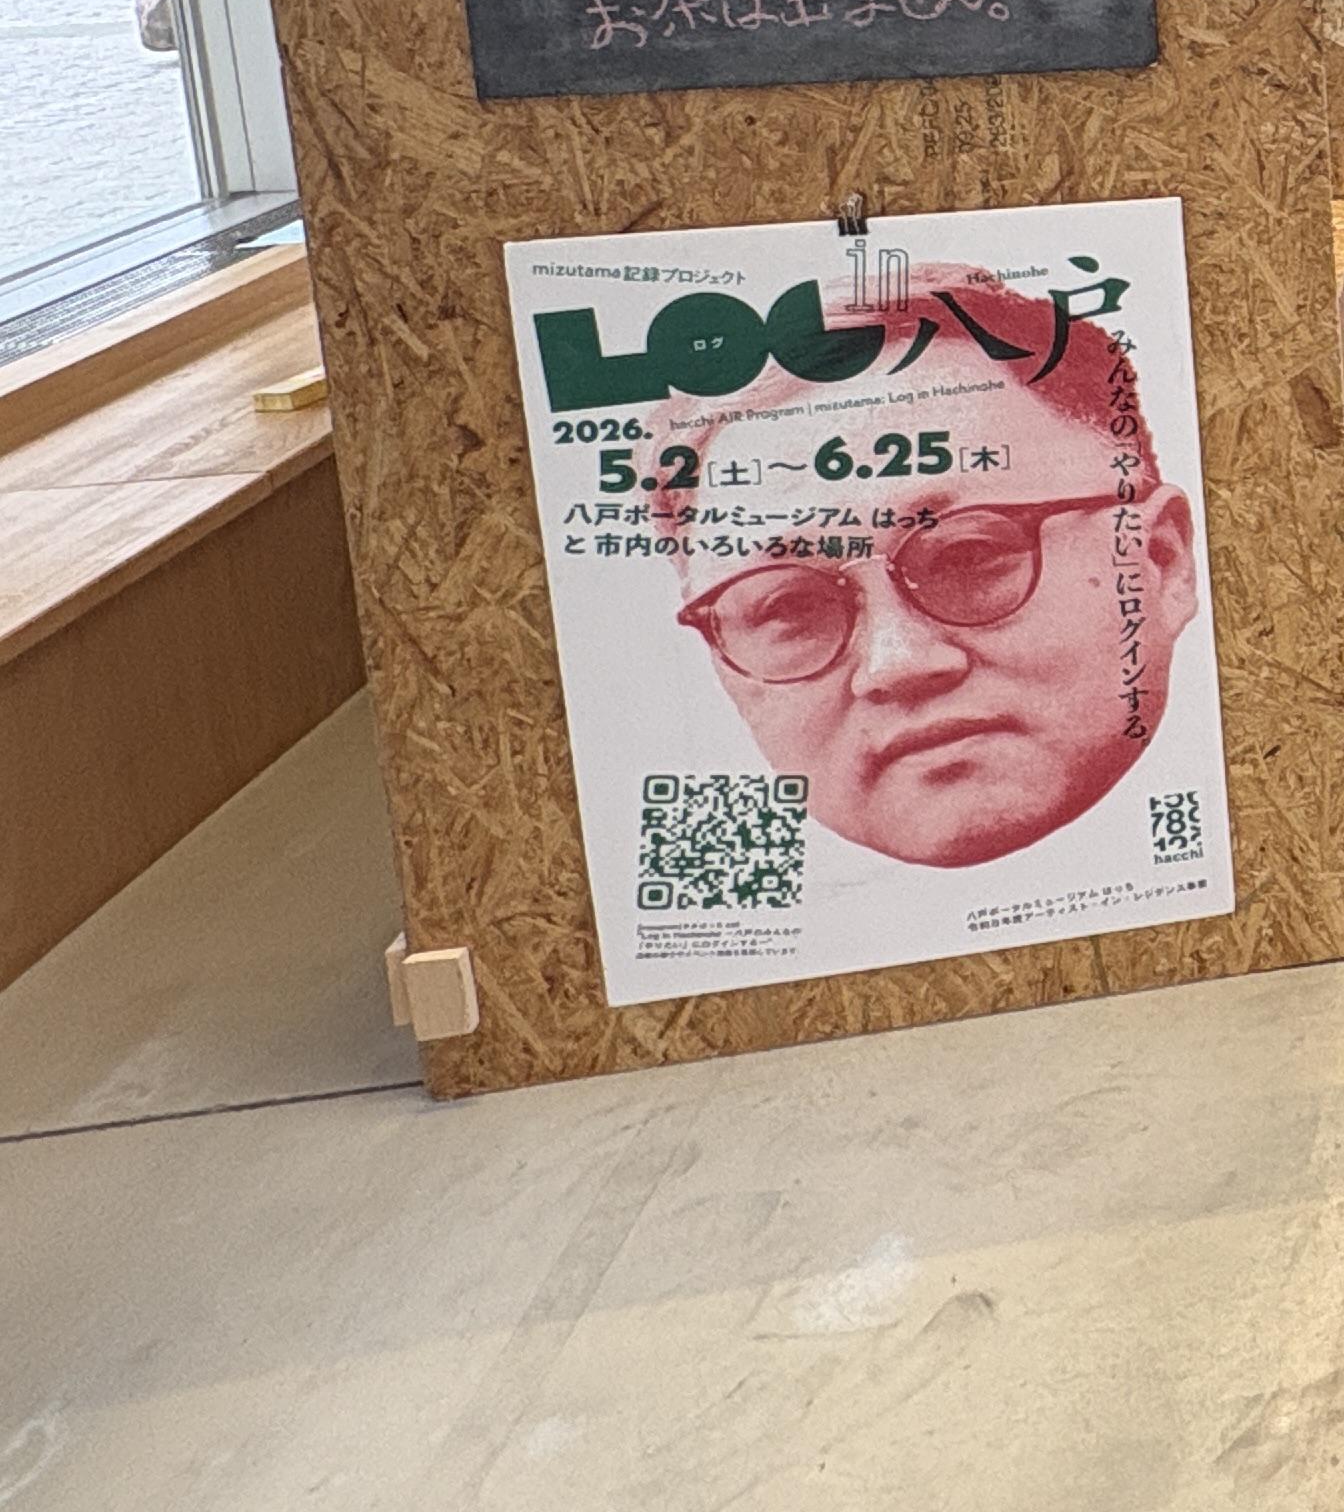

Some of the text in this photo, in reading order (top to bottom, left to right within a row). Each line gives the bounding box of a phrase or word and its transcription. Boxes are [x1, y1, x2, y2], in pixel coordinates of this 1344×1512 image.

[966, 265, 1049, 285] Hachinohe
[533, 279, 885, 413] LOG
[886, 256, 1131, 386] 八戸
[693, 336, 724, 351] ログ
[888, 391, 914, 406] Log
[932, 379, 1006, 398] Hachinohe
[552, 417, 654, 444] 2026.
[813, 431, 954, 481] 6.25
[563, 501, 940, 530] 八戸ポータルミュージアム はっち
[564, 534, 875, 560] と 市内のいろいろな場所
[1153, 841, 1205, 865] hacchi
